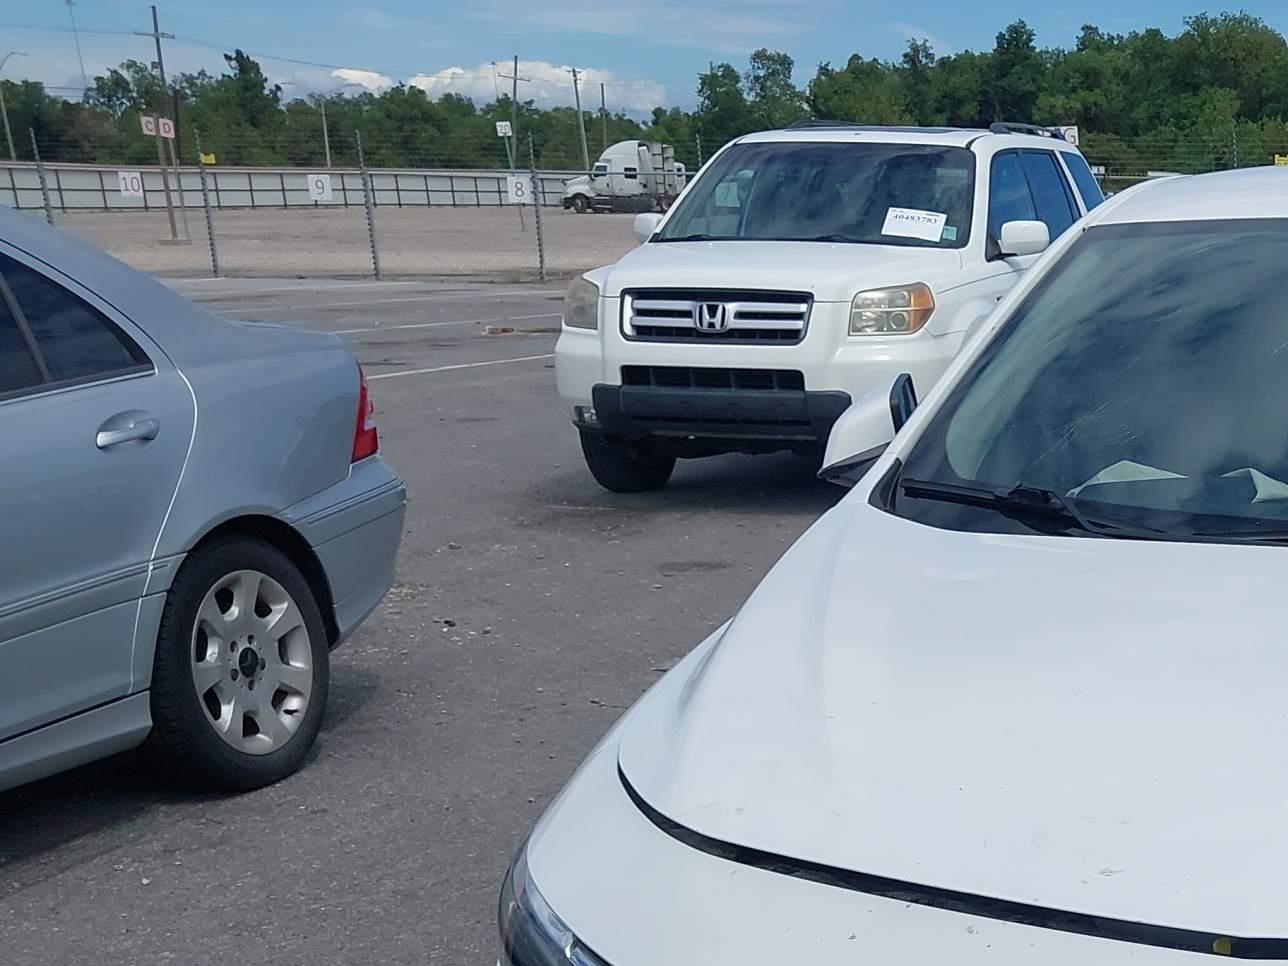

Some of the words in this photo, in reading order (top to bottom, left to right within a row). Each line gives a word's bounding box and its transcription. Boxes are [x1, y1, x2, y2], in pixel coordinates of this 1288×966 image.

[145, 120, 153, 132] C
[162, 122, 171, 134] D
[1063, 127, 1077, 145] G
[121, 176, 140, 193] 10
[314, 179, 325, 196] 9
[514, 181, 525, 198] 8
